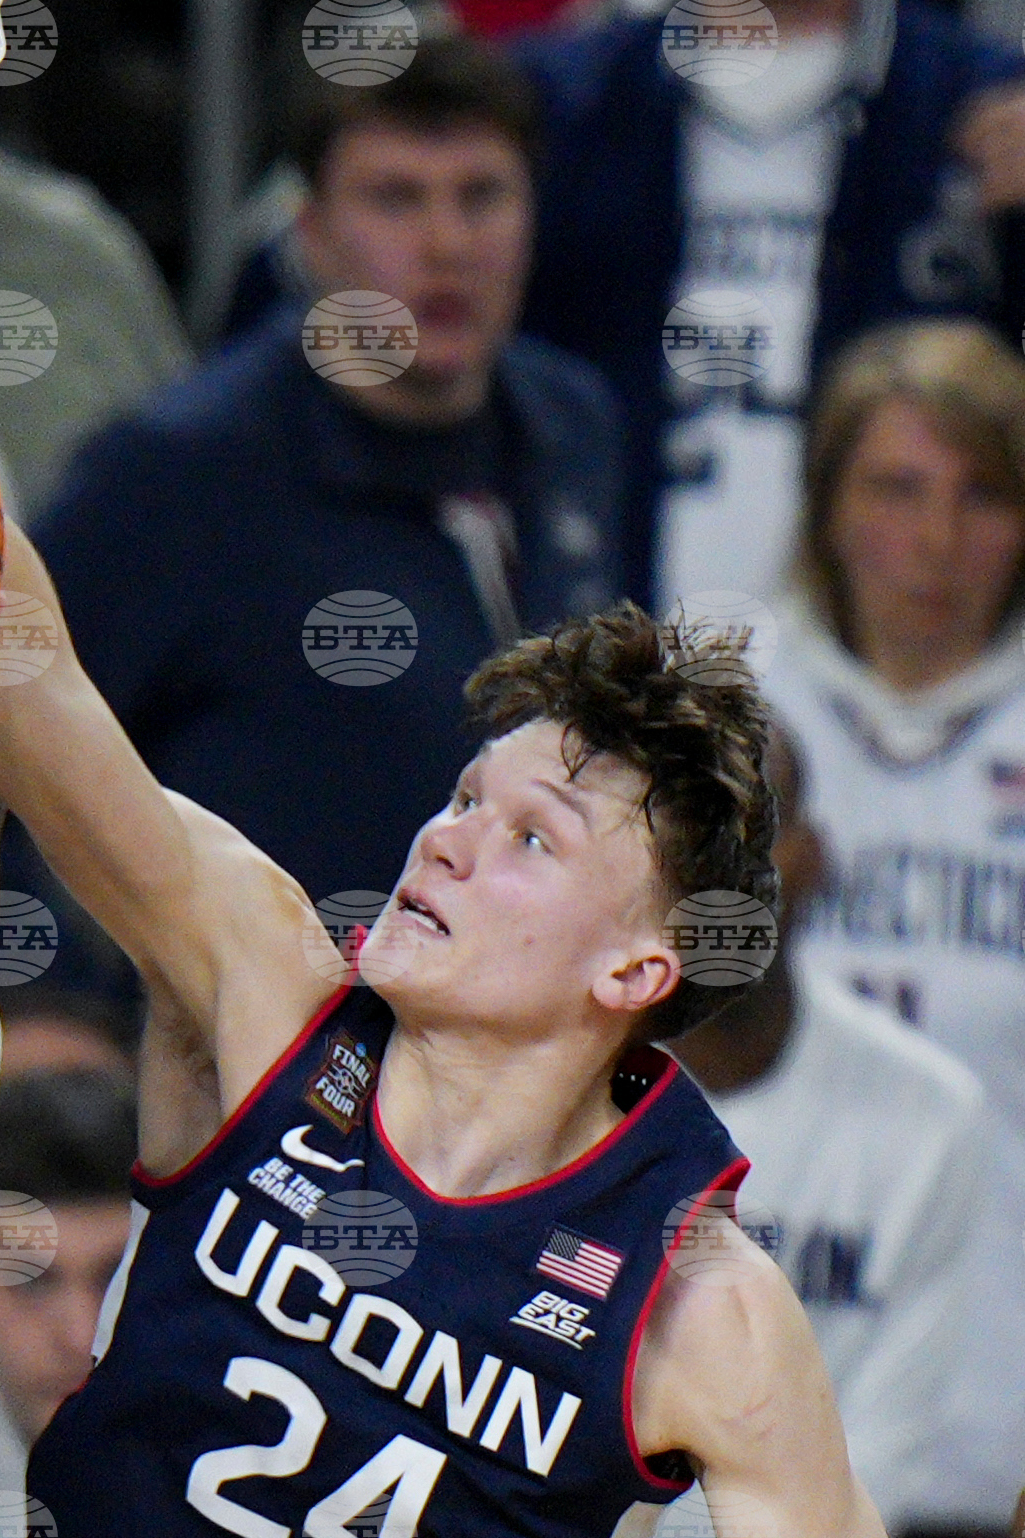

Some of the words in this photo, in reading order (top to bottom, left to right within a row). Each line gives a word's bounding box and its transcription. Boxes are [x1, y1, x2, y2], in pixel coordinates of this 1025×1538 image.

[331, 1043, 372, 1089] FINAL
[315, 1076, 356, 1118] FOUR
[247, 1167, 319, 1220] CHANGE
[263, 1157, 294, 1181] BE
[289, 1173, 327, 1204] THE
[517, 1303, 596, 1343] EAST
[531, 1290, 590, 1323] BIG
[194, 1187, 583, 1478] UCONN
